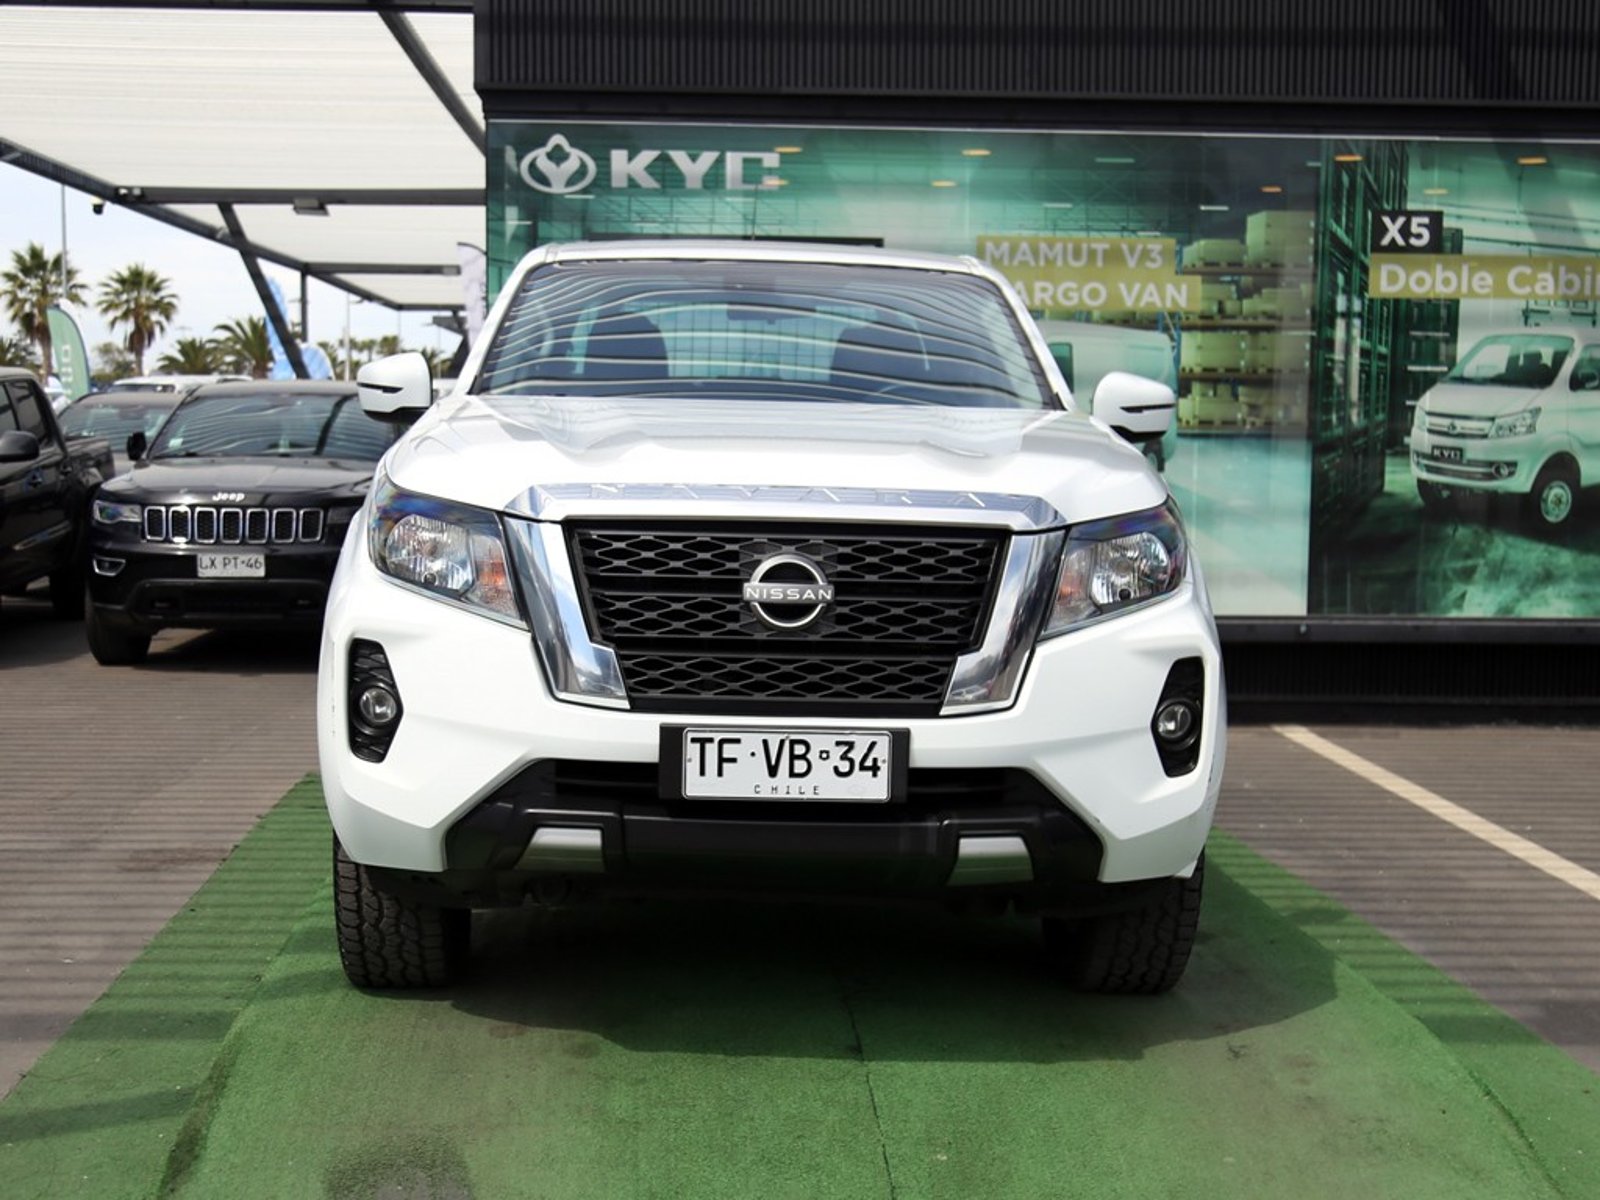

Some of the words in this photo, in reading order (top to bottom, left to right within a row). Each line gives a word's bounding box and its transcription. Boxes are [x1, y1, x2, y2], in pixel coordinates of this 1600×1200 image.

[610, 149, 780, 190] KYC
[1379, 215, 1431, 247] X5
[984, 241, 1110, 268] MAMUT
[1120, 243, 1164, 269] V3
[1379, 262, 1494, 294] Doble
[1507, 264, 1600, 295] Cabi
[1013, 281, 1107, 306] ARGO
[1118, 283, 1188, 308] VAN
[212, 492, 245, 502] Jeep
[746, 586, 833, 601] NISSAN
[754, 784, 820, 796] CHILE
